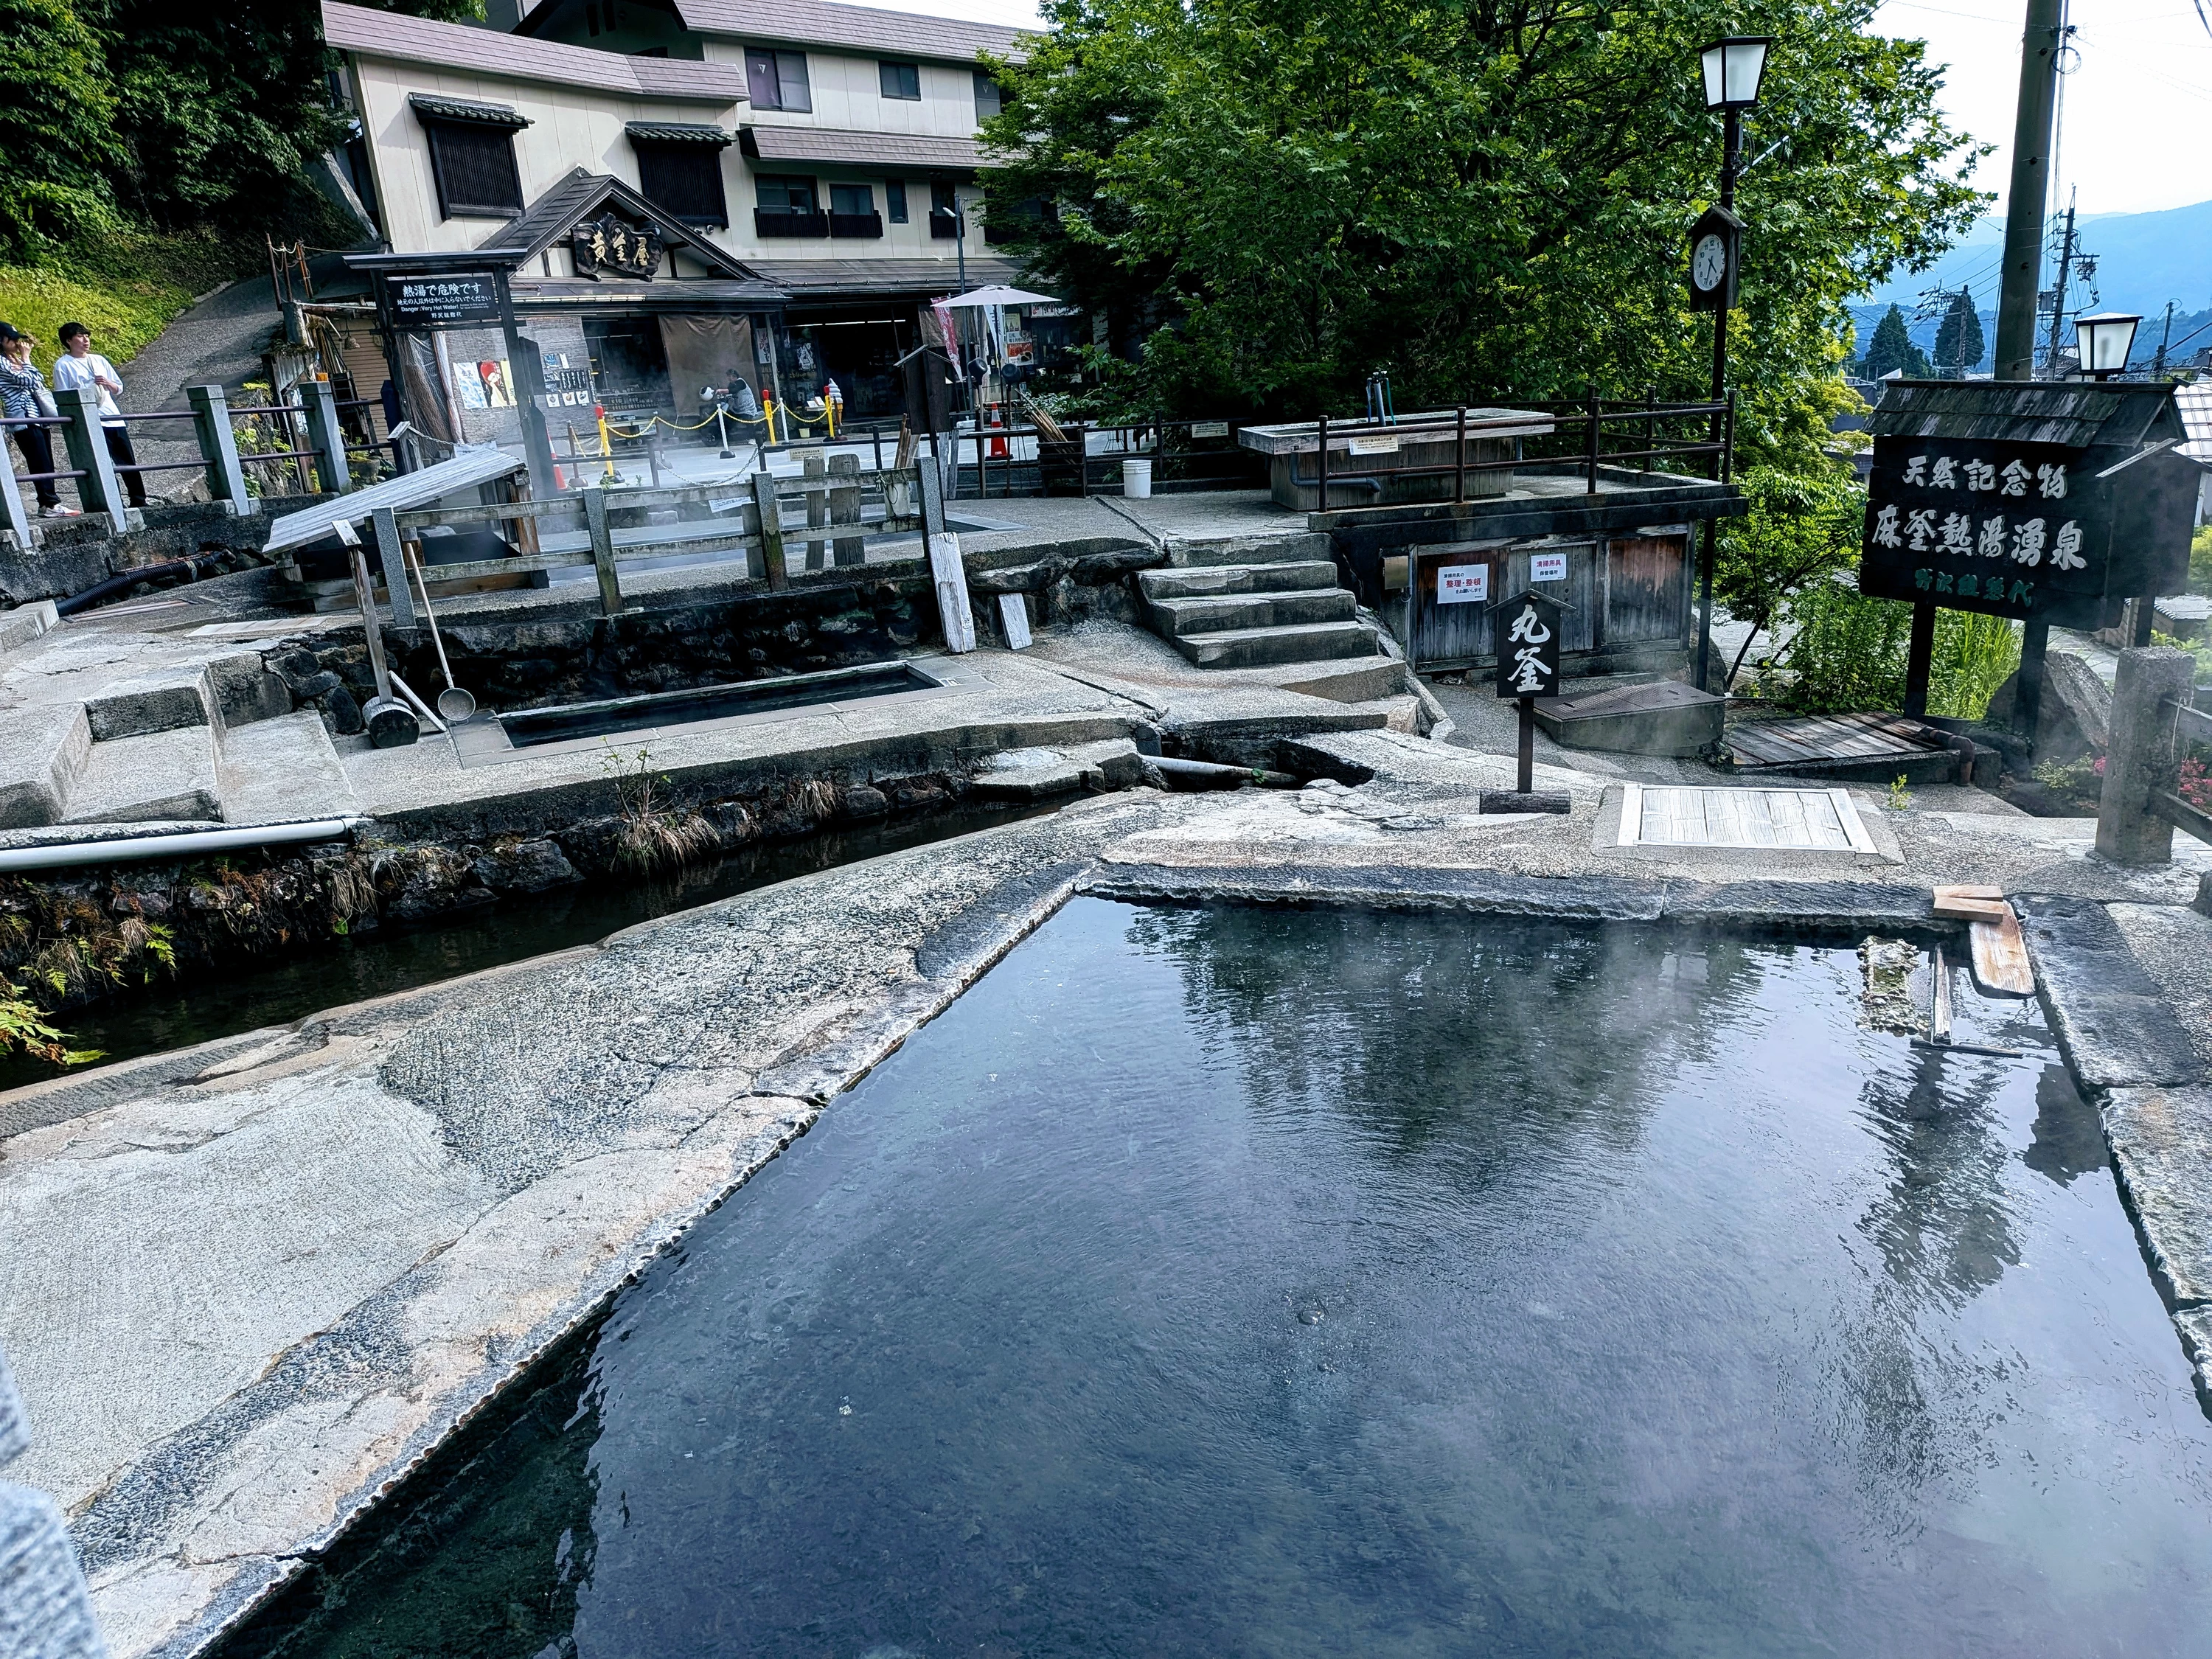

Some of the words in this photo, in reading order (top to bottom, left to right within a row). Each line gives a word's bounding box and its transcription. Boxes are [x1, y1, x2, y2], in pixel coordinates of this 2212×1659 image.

[397, 296, 491, 305] 地元の人以外は中に入らないでください
[403, 282, 481, 297] 熱湯で危険です
[1902, 455, 2067, 499] 天然記念物
[1872, 504, 2088, 571] 麻釜熱湯湧泉
[1536, 559, 1562, 568] 清掃用具
[1446, 577, 1482, 588] 整理・整頓
[1914, 568, 2034, 608] 野沢組惣代
[1507, 604, 1552, 692] 丸釜
